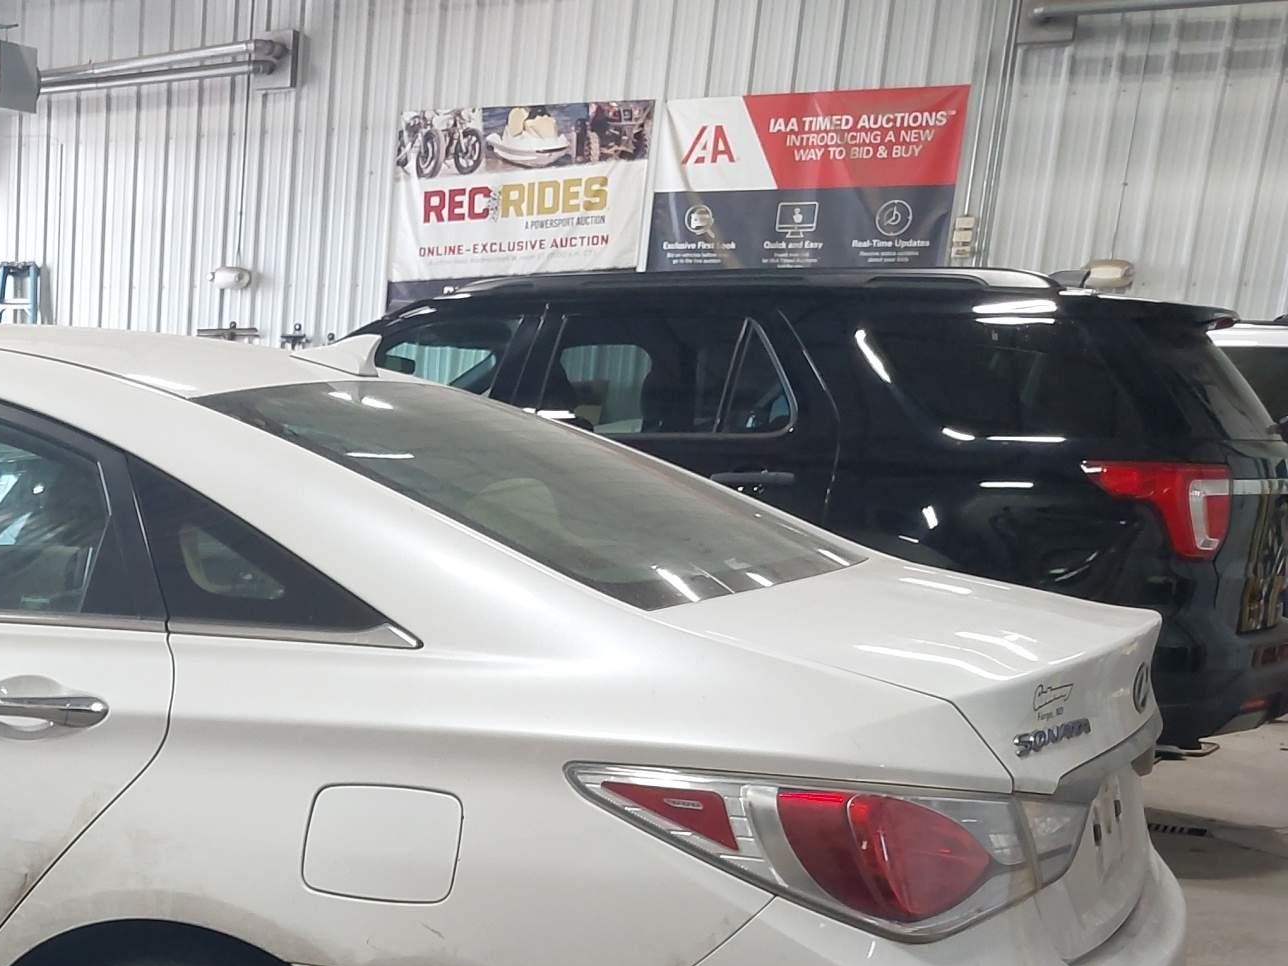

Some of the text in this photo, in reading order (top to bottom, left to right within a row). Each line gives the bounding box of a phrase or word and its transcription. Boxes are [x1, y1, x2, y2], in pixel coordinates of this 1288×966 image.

[769, 117, 799, 133] IAA
[802, 114, 853, 132] TIMED
[786, 129, 935, 147] INTRODUCING A NEW
[793, 144, 924, 161] WAY TO BID & BUY
[423, 176, 609, 224] REC RIDES
[576, 215, 606, 227] AUCTION
[419, 234, 610, 257] ONLINE-EXCLUSIVE AUCTION
[763, 241, 786, 249] Quick
[804, 240, 823, 249] Easy
[894, 239, 930, 248] Updates
[1013, 718, 1091, 757] SONATA
